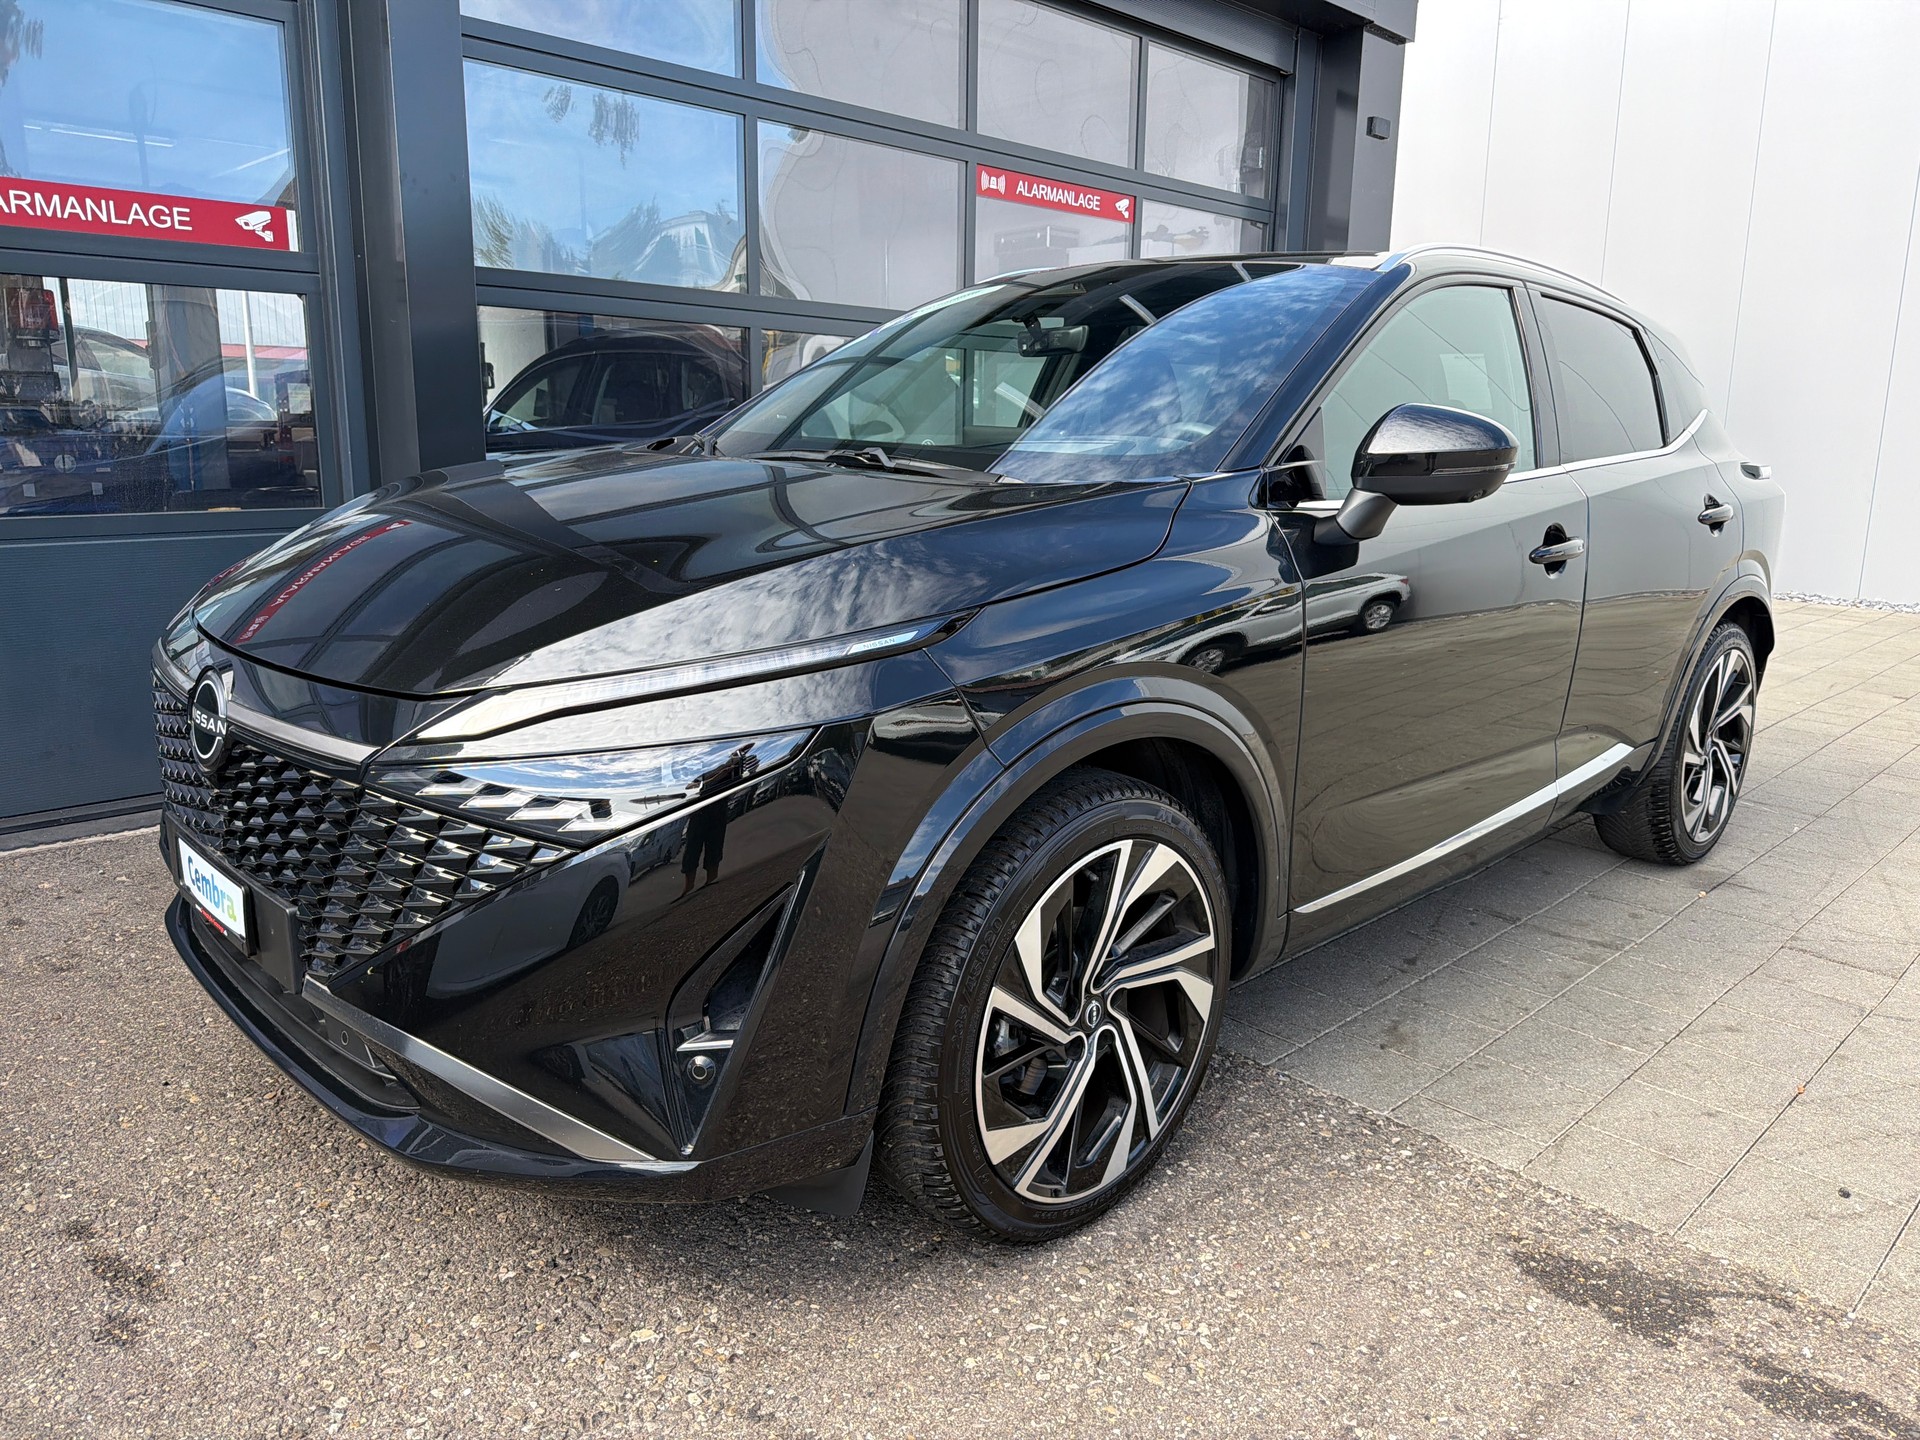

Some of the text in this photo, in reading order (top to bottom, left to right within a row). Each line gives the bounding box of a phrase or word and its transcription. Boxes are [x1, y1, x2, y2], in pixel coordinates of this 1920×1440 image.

[1016, 180, 1101, 211] ALARMANLAGE
[863, 638, 896, 649] NISSAN
[193, 705, 227, 735] ISSAN
[188, 855, 237, 922] Cembra
